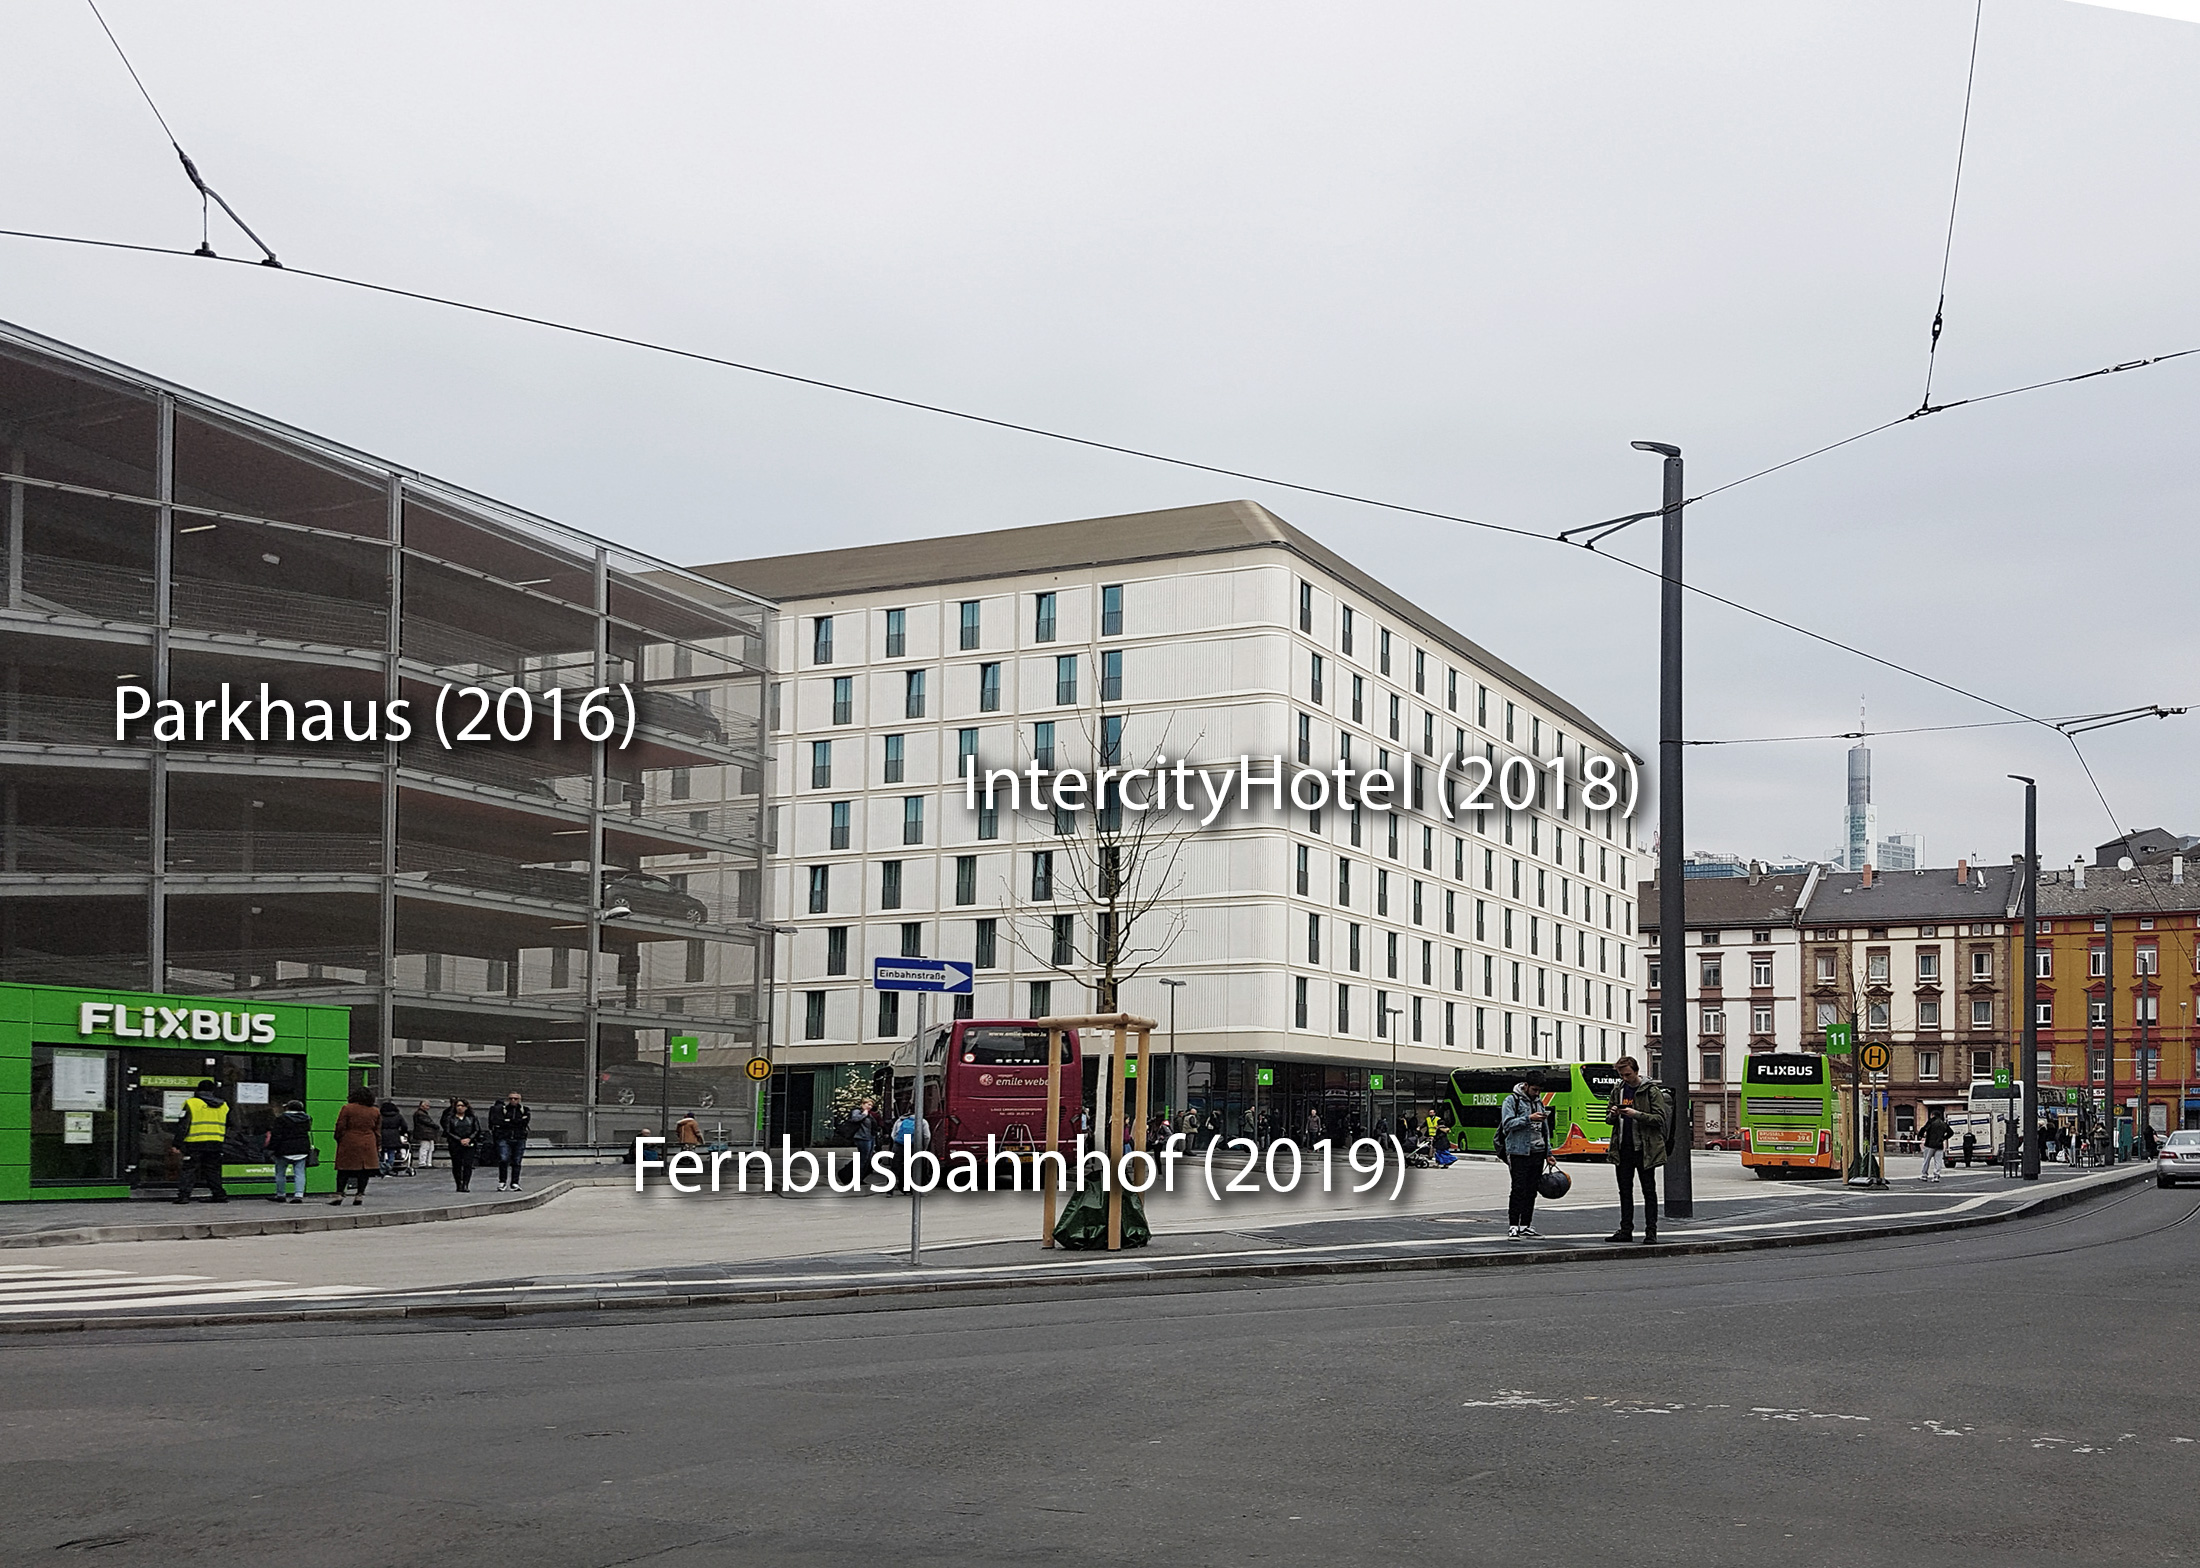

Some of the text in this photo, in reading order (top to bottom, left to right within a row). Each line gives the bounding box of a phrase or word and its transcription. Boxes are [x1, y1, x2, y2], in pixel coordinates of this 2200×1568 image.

[879, 969, 946, 981] Einbahnstraße
[1830, 1032, 1845, 1046] 11
[680, 1044, 688, 1055] 1
[1868, 1048, 1882, 1065] H
[753, 1062, 765, 1076] H
[1129, 1064, 1137, 1073] 3
[995, 1077, 1023, 1086] emile
[1262, 1073, 1269, 1081] 4
[1374, 1078, 1380, 1086] 5
[1996, 1074, 2007, 1084] 12
